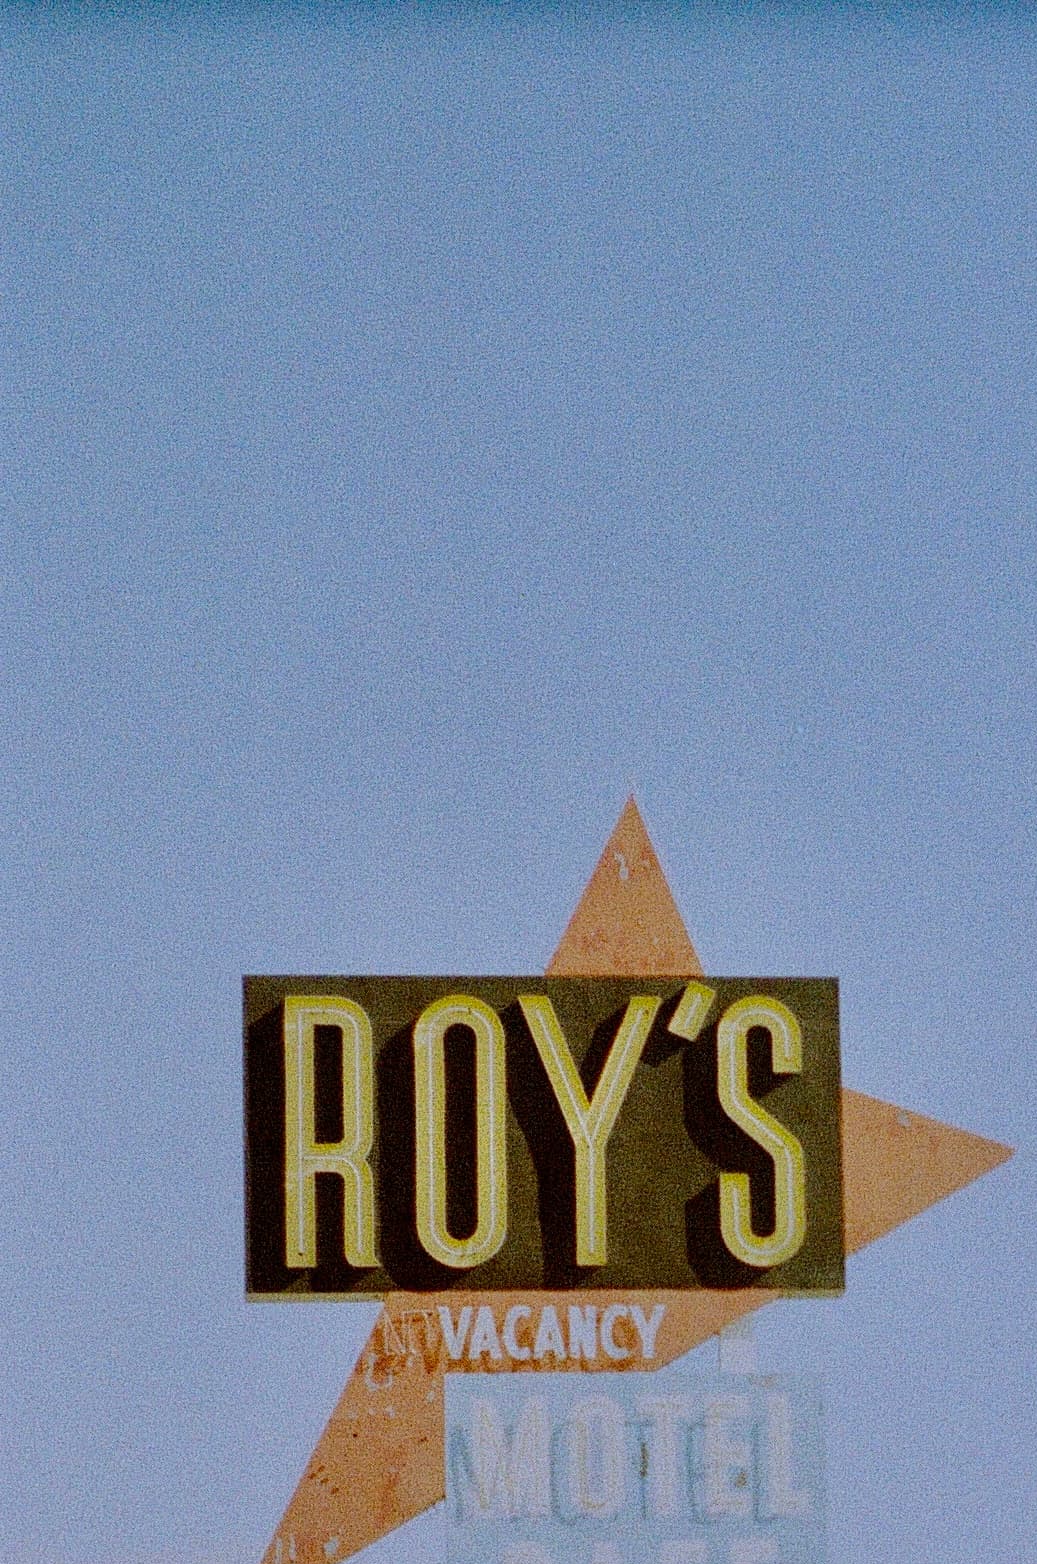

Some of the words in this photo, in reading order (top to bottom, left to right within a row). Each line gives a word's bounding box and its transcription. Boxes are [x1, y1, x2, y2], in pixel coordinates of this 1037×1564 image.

[284, 981, 804, 1268] ROY'S
[438, 1305, 666, 1360] VACANCY
[468, 1395, 812, 1519] MOTEL
